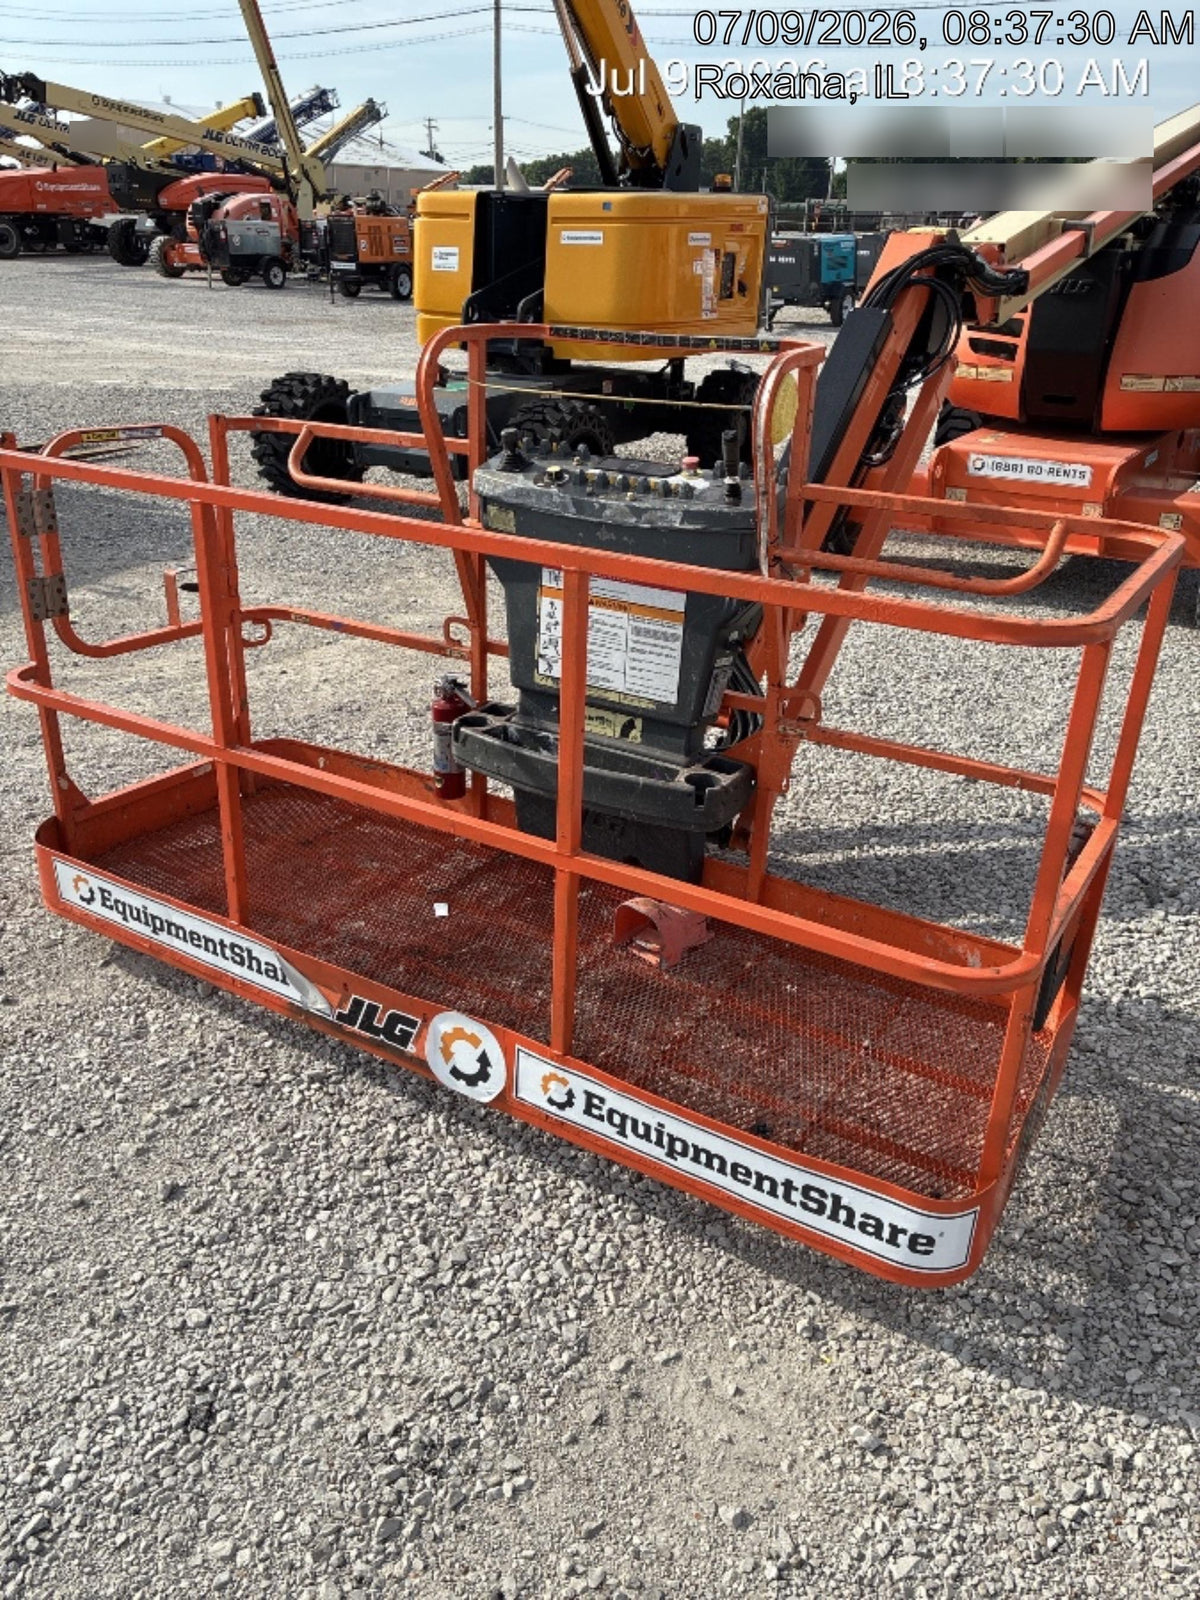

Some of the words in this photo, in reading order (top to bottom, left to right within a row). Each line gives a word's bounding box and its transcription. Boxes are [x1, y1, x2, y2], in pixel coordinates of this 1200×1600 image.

[13, 109, 37, 125] JLG
[202, 127, 224, 143] JLG
[334, 995, 421, 1051] JLG
[582, 1088, 937, 1257] EquipmentShare
